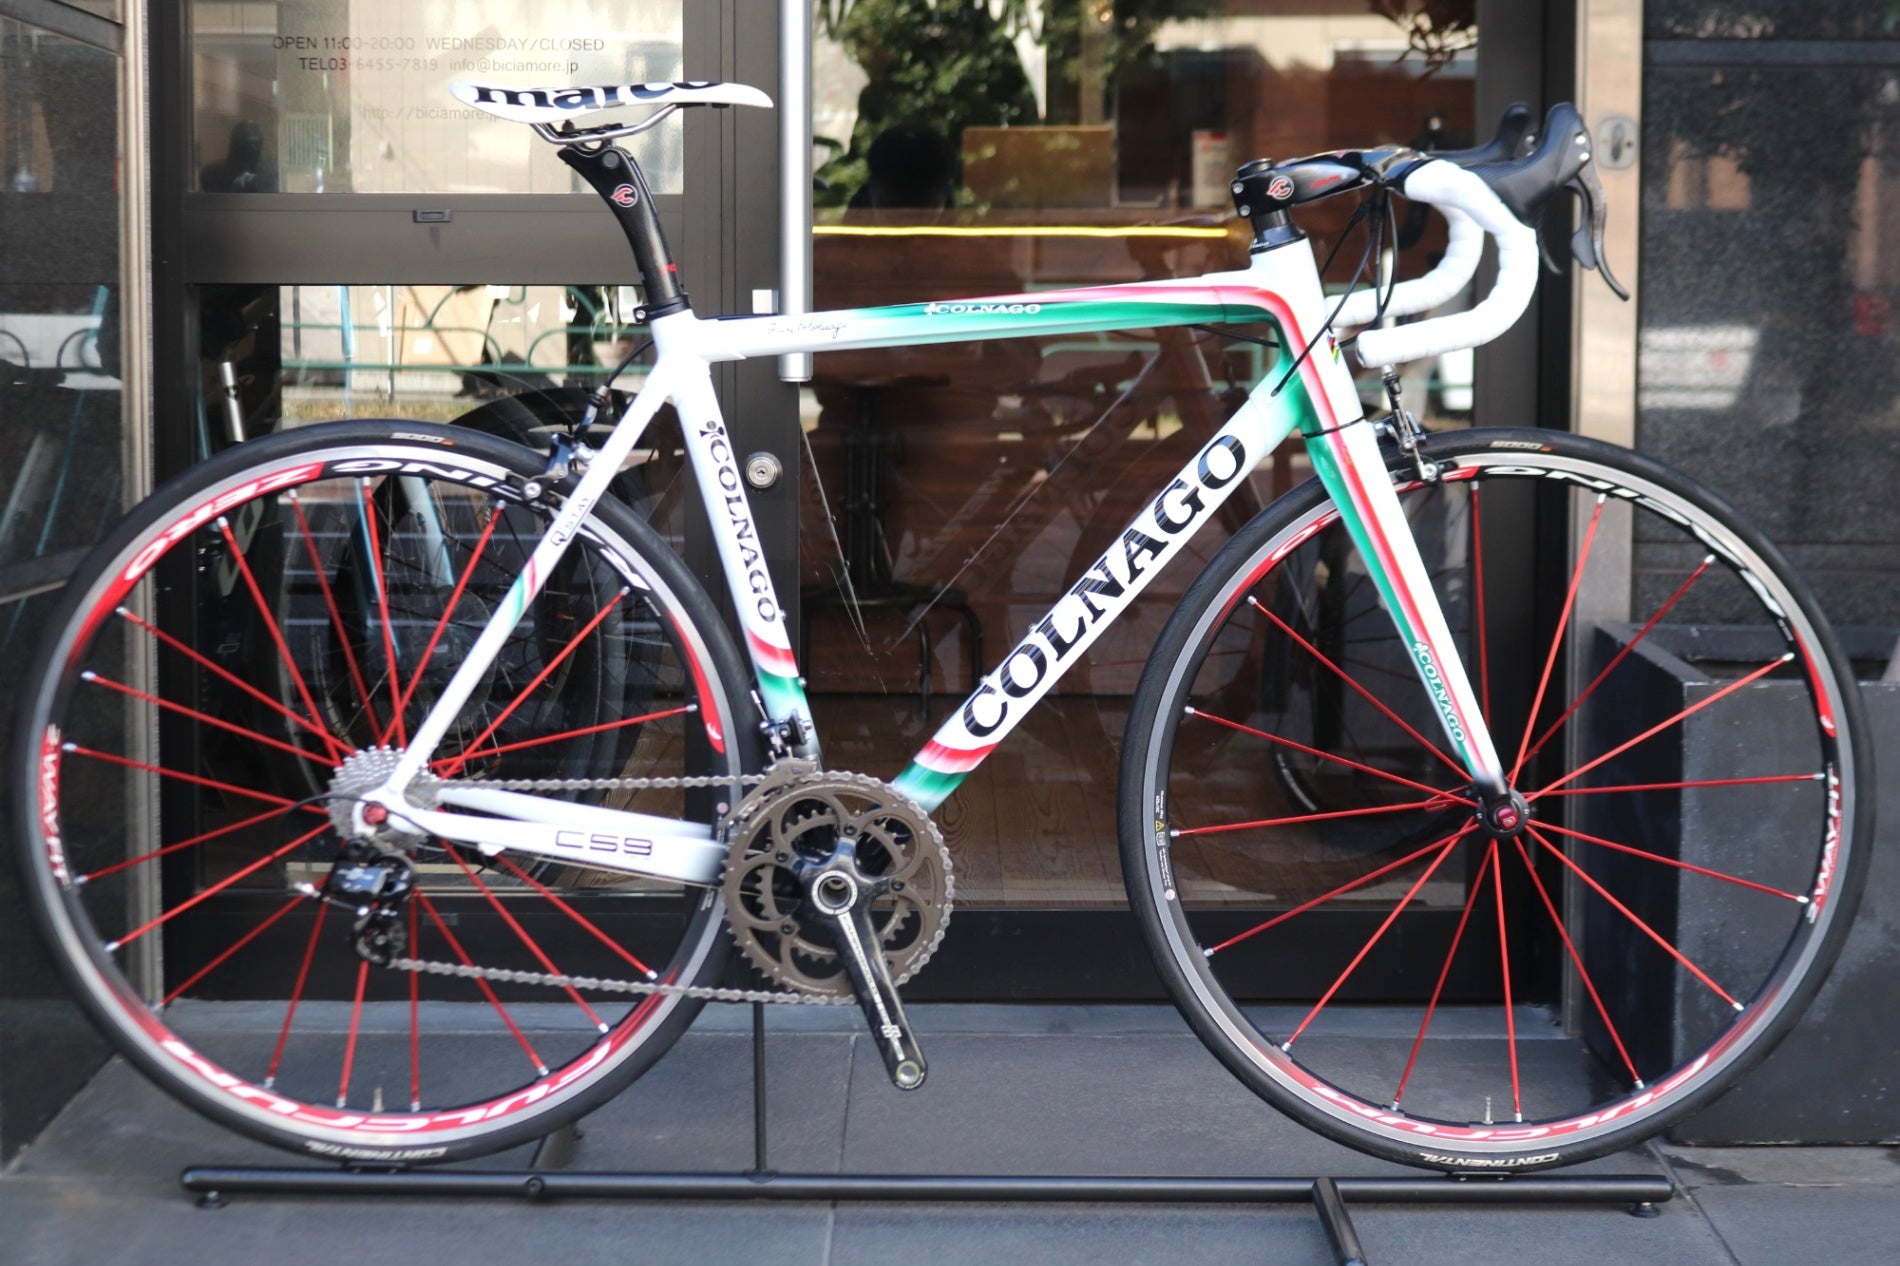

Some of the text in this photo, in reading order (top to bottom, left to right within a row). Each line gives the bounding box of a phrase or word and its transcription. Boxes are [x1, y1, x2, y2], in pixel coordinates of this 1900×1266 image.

[272, 36, 605, 51] OPEN 11:00-20:00 WEDNESDAY/CLOSED
[450, 58, 579, 74] info@biciamore.jp
[936, 303, 1042, 315] COLNAGO
[125, 465, 317, 581] ZERO
[710, 439, 776, 623] COLNAGO
[963, 435, 1246, 738] COLNAGO
[1418, 651, 1465, 742] COLNAGO
[555, 830, 653, 857] C59
[161, 1040, 610, 1132] FULCRUM
[1313, 1053, 1709, 1140] FULCRUM
[1419, 1152, 1560, 1168] CONTINENTAL
